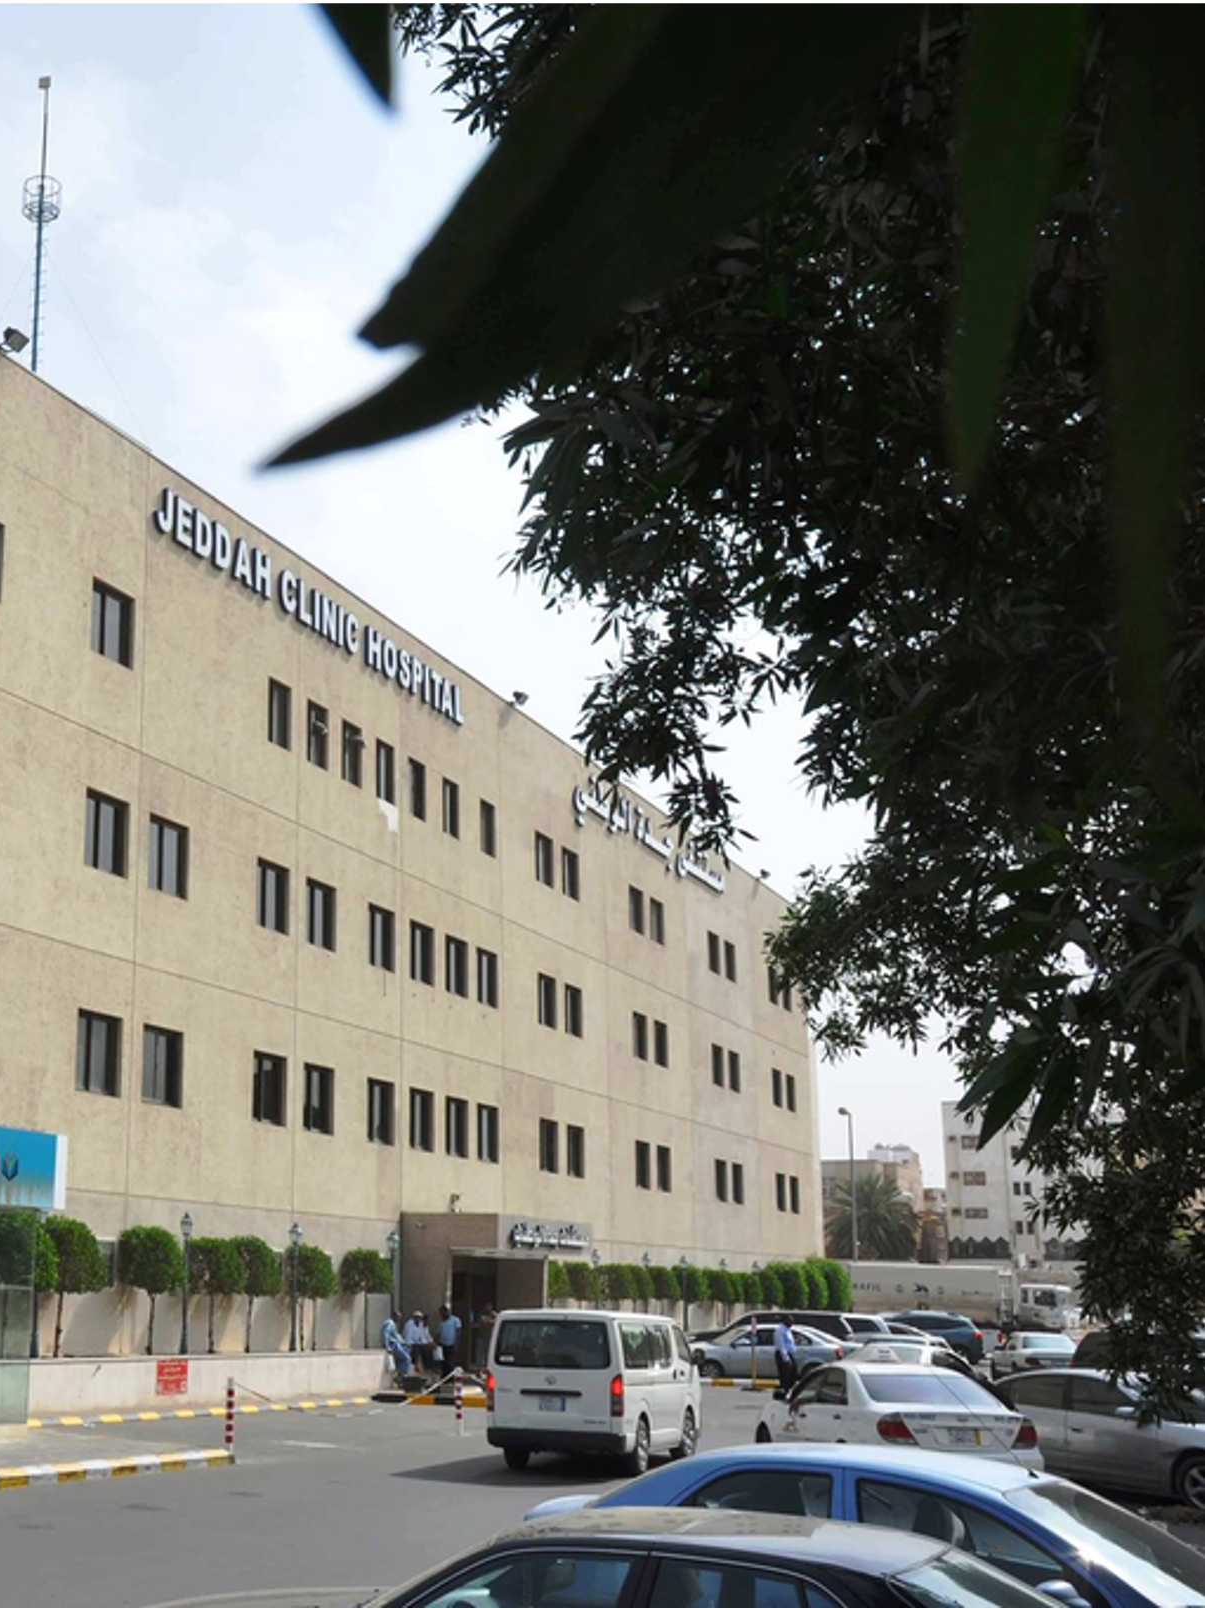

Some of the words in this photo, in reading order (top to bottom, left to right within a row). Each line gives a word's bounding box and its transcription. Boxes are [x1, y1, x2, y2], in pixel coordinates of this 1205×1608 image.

[154, 486, 272, 600] JEDDAH
[278, 568, 360, 655] CLINIC
[363, 624, 466, 726] HOSPITAL
